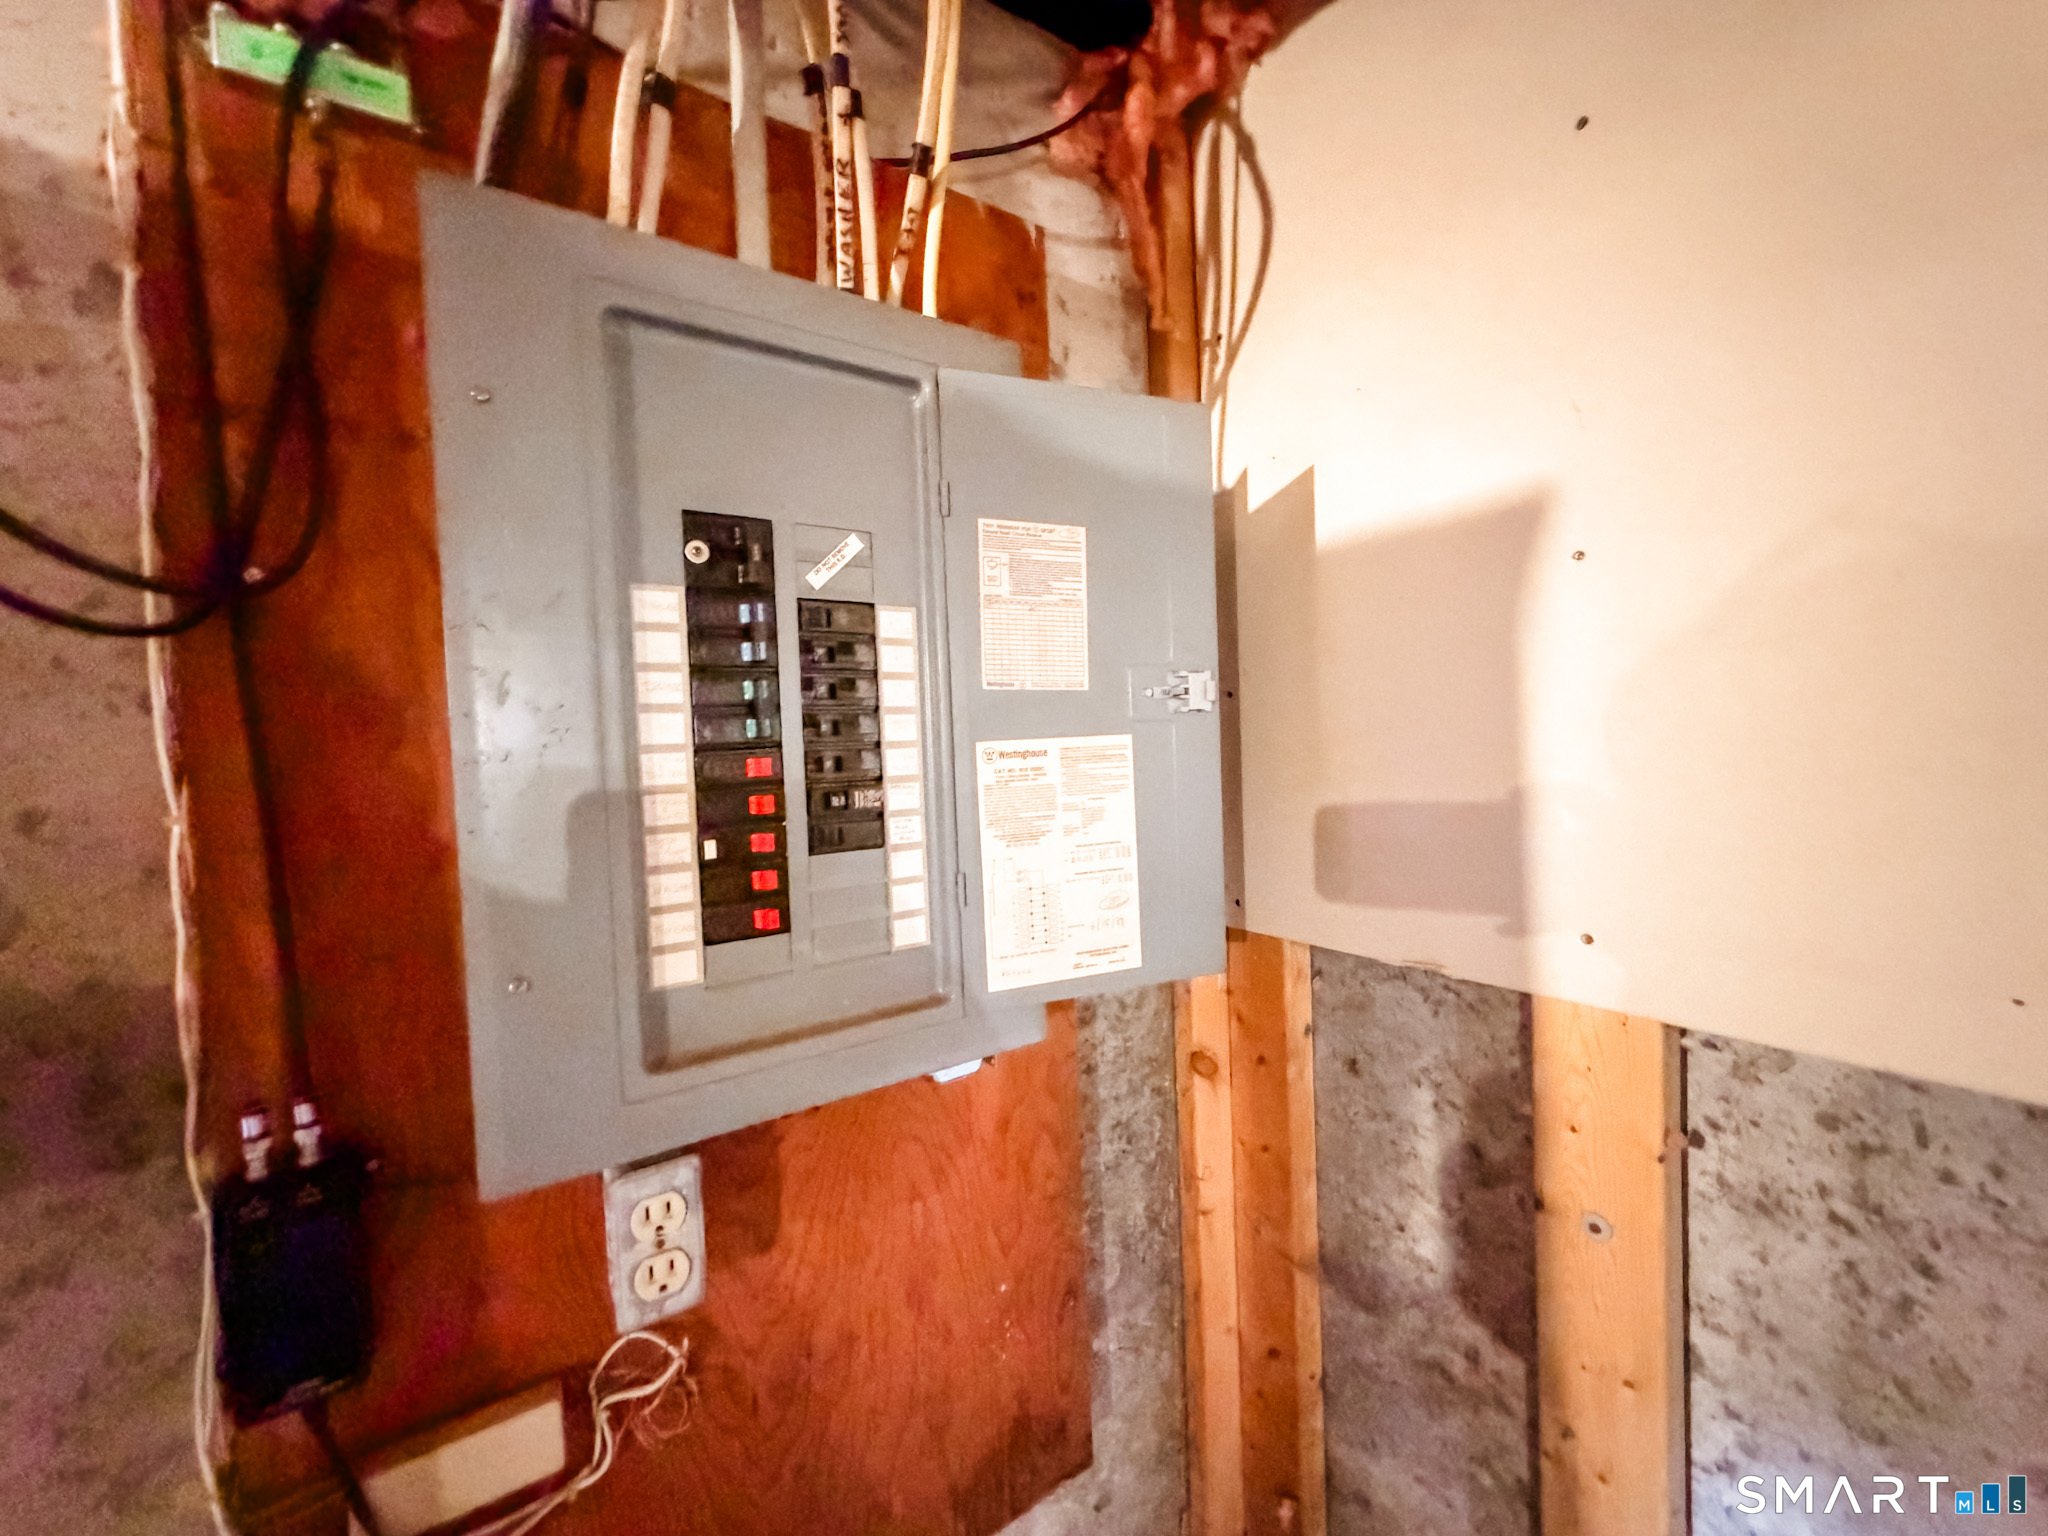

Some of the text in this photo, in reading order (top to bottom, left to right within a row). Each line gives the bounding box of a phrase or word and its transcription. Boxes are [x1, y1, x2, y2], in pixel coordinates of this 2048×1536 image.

[836, 158, 854, 284] WASHER
[813, 541, 849, 575] DO NOT REMOVE
[998, 749, 1048, 760] Westinghouse
